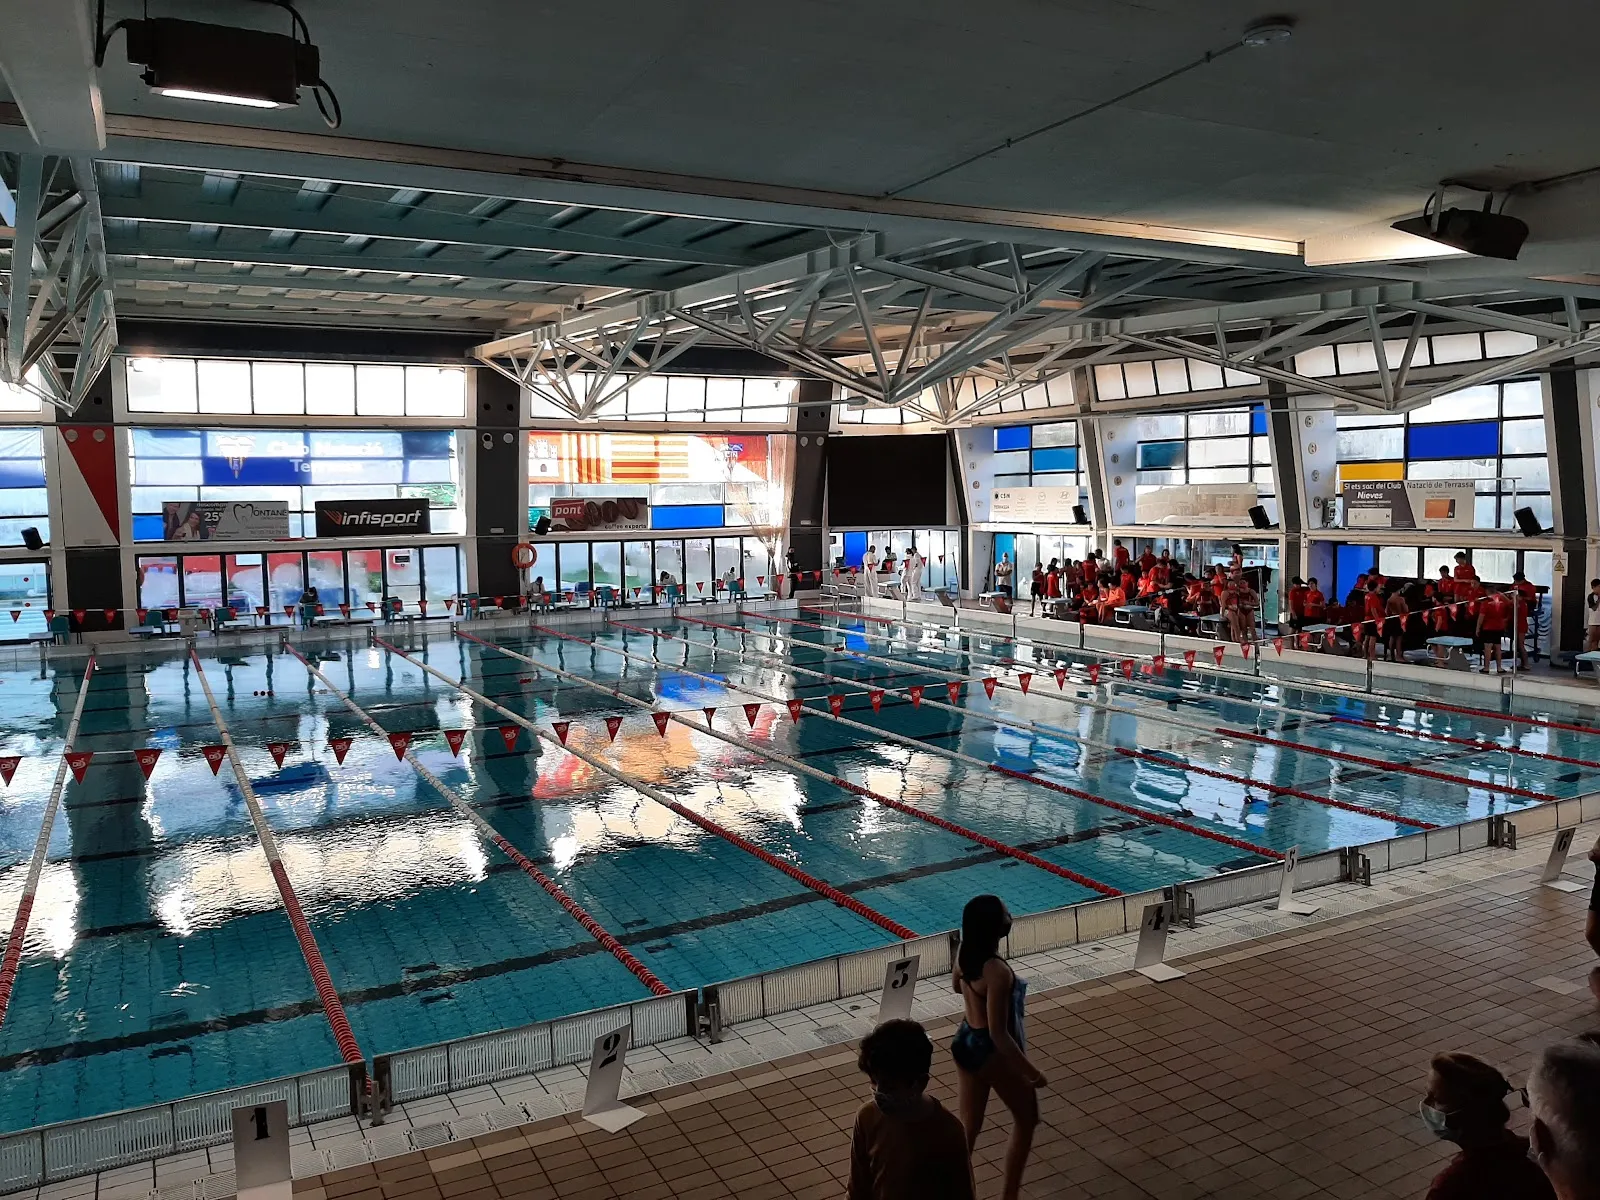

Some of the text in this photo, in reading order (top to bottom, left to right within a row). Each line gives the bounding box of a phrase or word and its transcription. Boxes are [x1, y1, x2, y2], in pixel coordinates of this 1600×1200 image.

[1357, 491, 1383, 499] Nieves
[342, 509, 422, 527] infisport
[555, 506, 582, 516] pont
[1557, 831, 1570, 852] 6
[1286, 848, 1296, 873] 5
[1147, 904, 1164, 932] 4
[890, 961, 911, 990] 3
[600, 1033, 622, 1069] 2
[250, 1107, 270, 1141] 1
